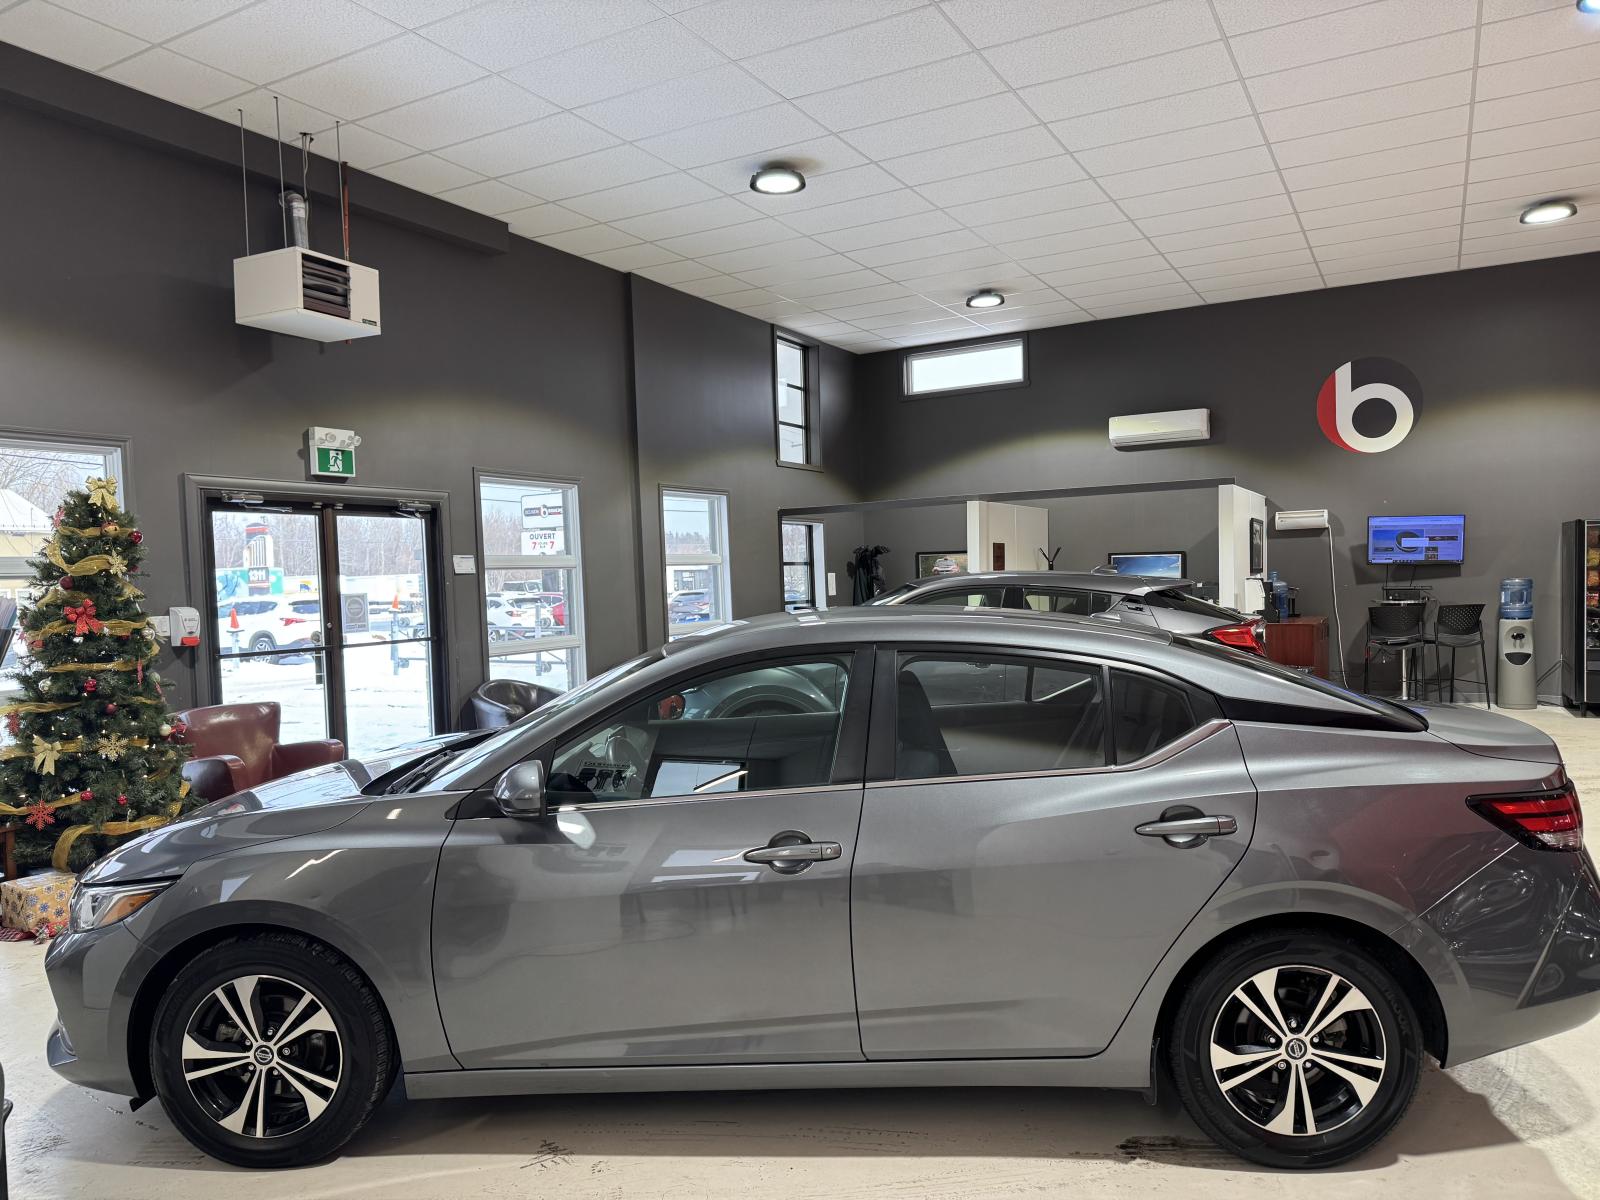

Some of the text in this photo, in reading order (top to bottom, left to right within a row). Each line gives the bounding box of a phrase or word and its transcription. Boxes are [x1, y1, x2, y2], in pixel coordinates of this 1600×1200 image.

[1335, 361, 1414, 453] b
[532, 541, 537, 550] 7
[550, 541, 554, 549] 7
